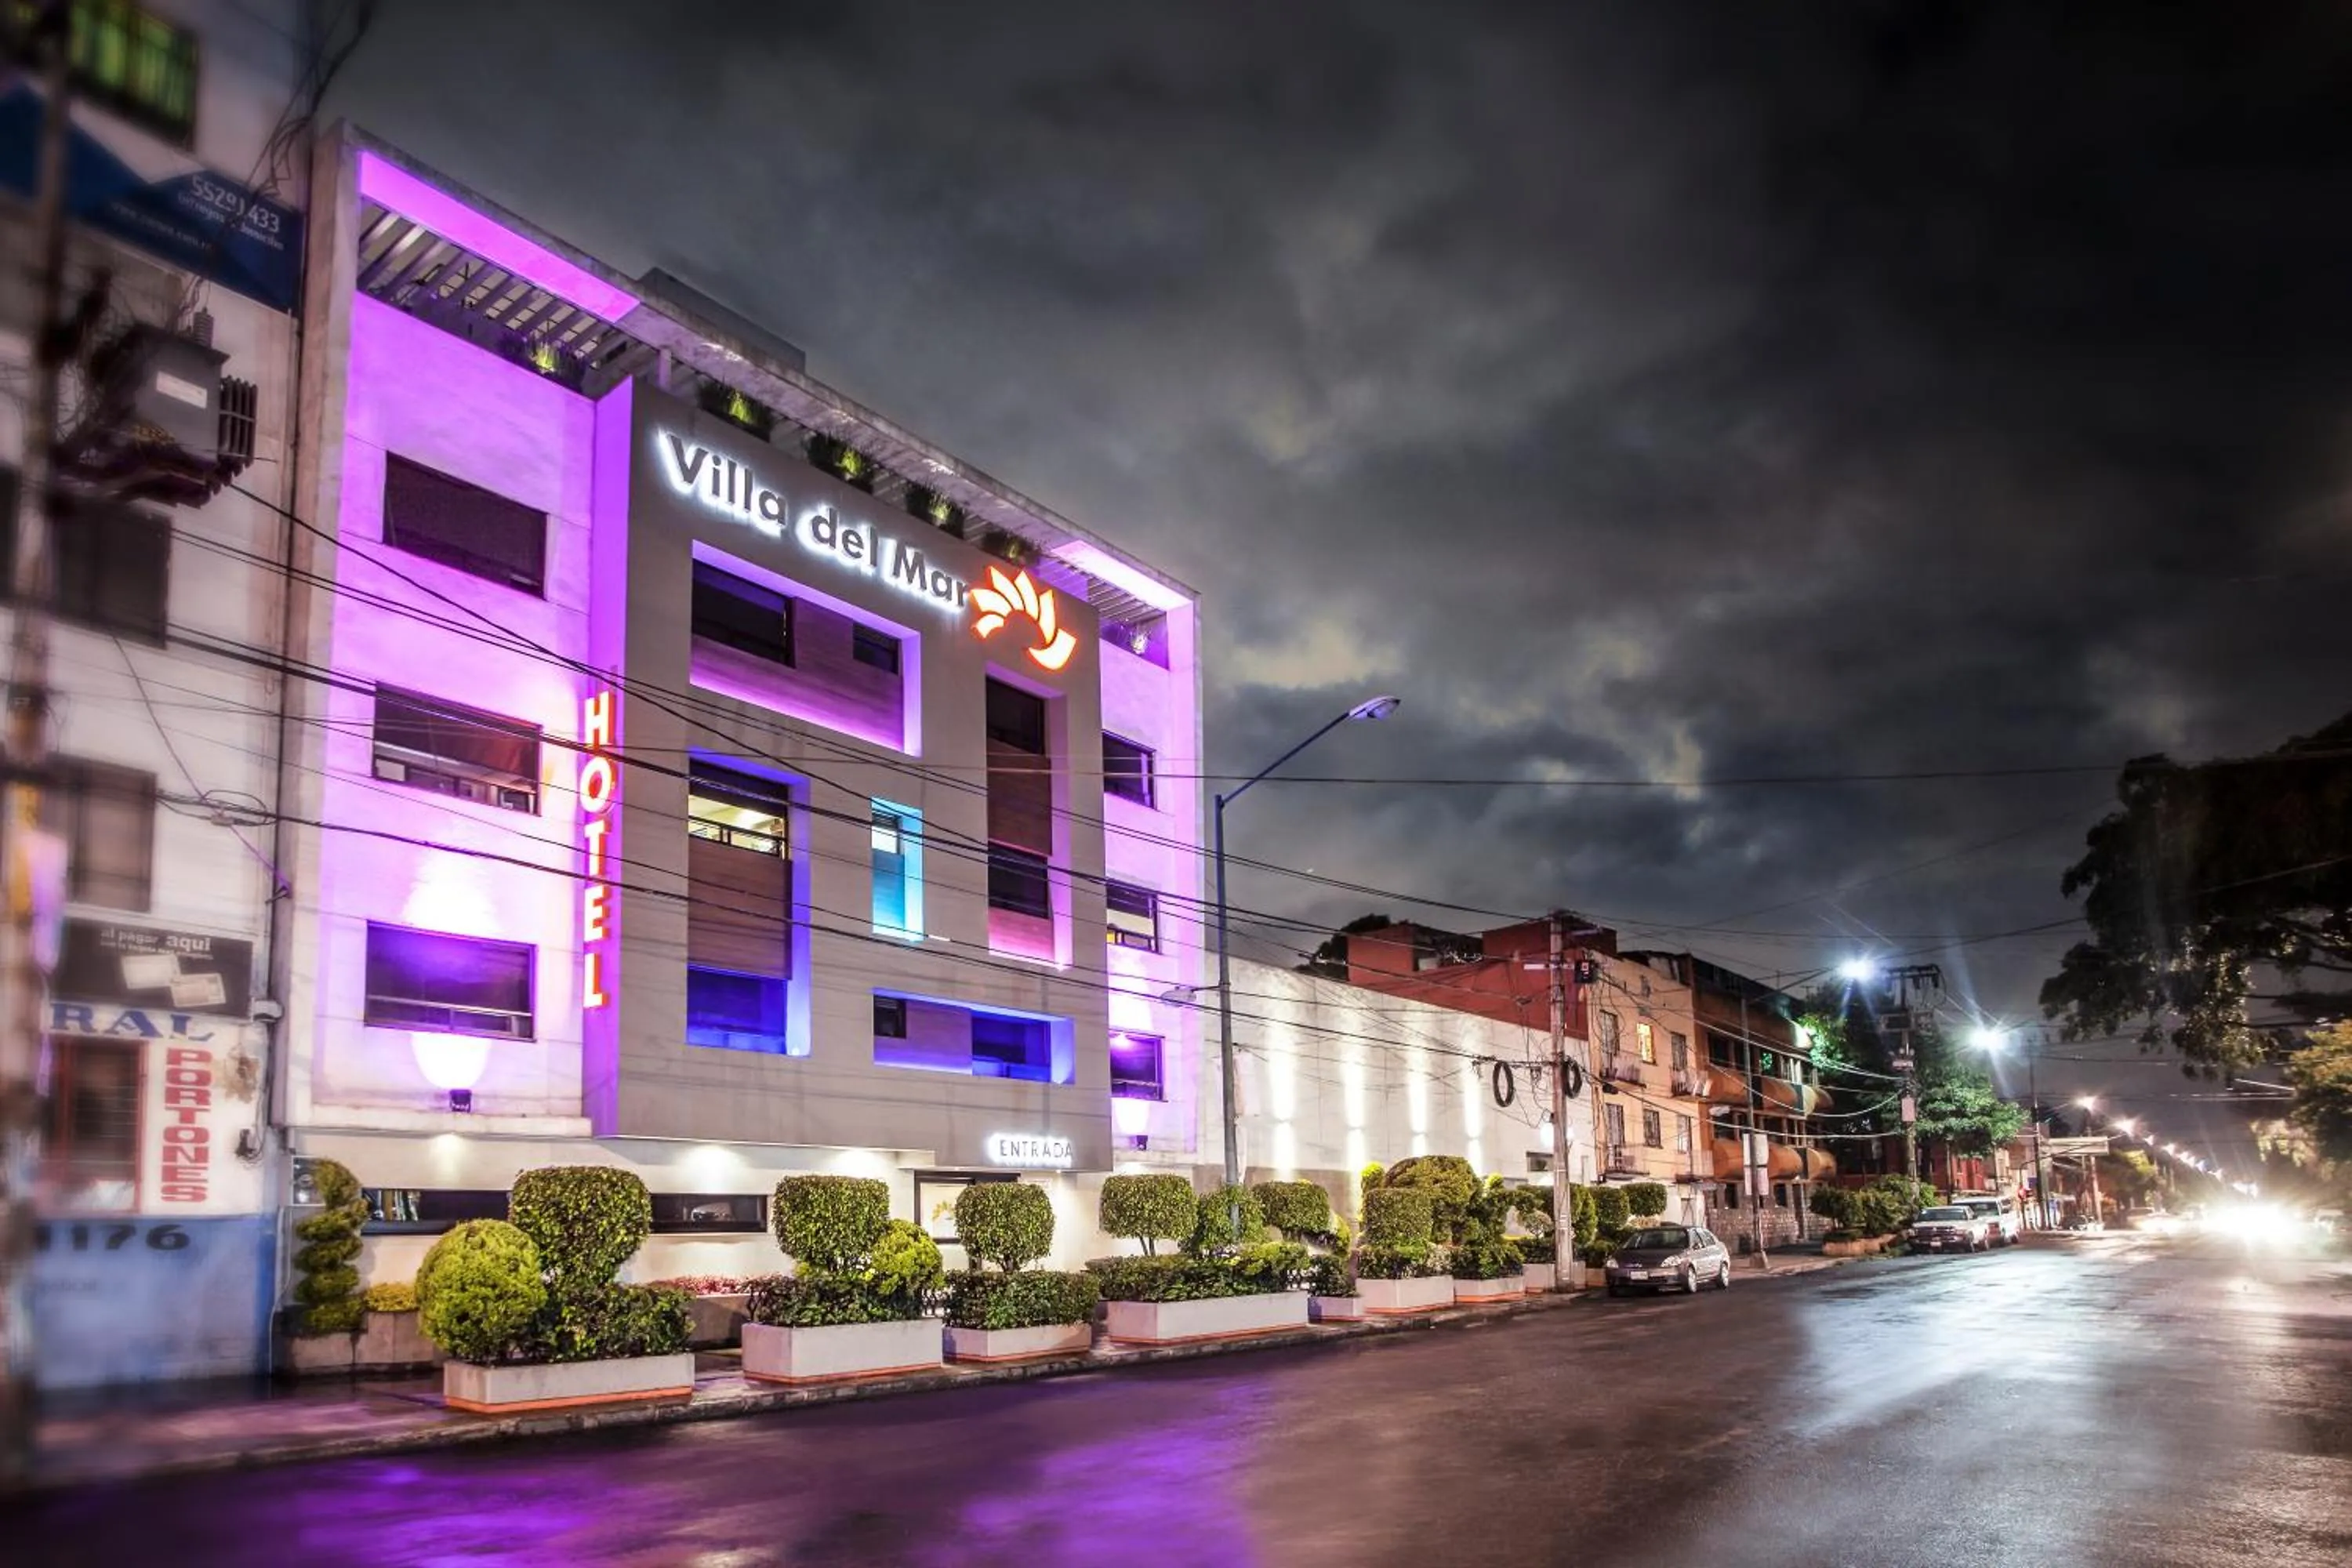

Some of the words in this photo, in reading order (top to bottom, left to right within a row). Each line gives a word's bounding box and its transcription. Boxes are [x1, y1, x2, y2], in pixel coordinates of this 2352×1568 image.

[666, 433, 786, 526] Villa
[811, 506, 880, 567] del
[891, 540, 971, 608] Mar
[579, 690, 616, 1009] HOTEL
[161, 1047, 212, 1203] PORTONES
[1000, 1139, 1073, 1159] ENTRADA
